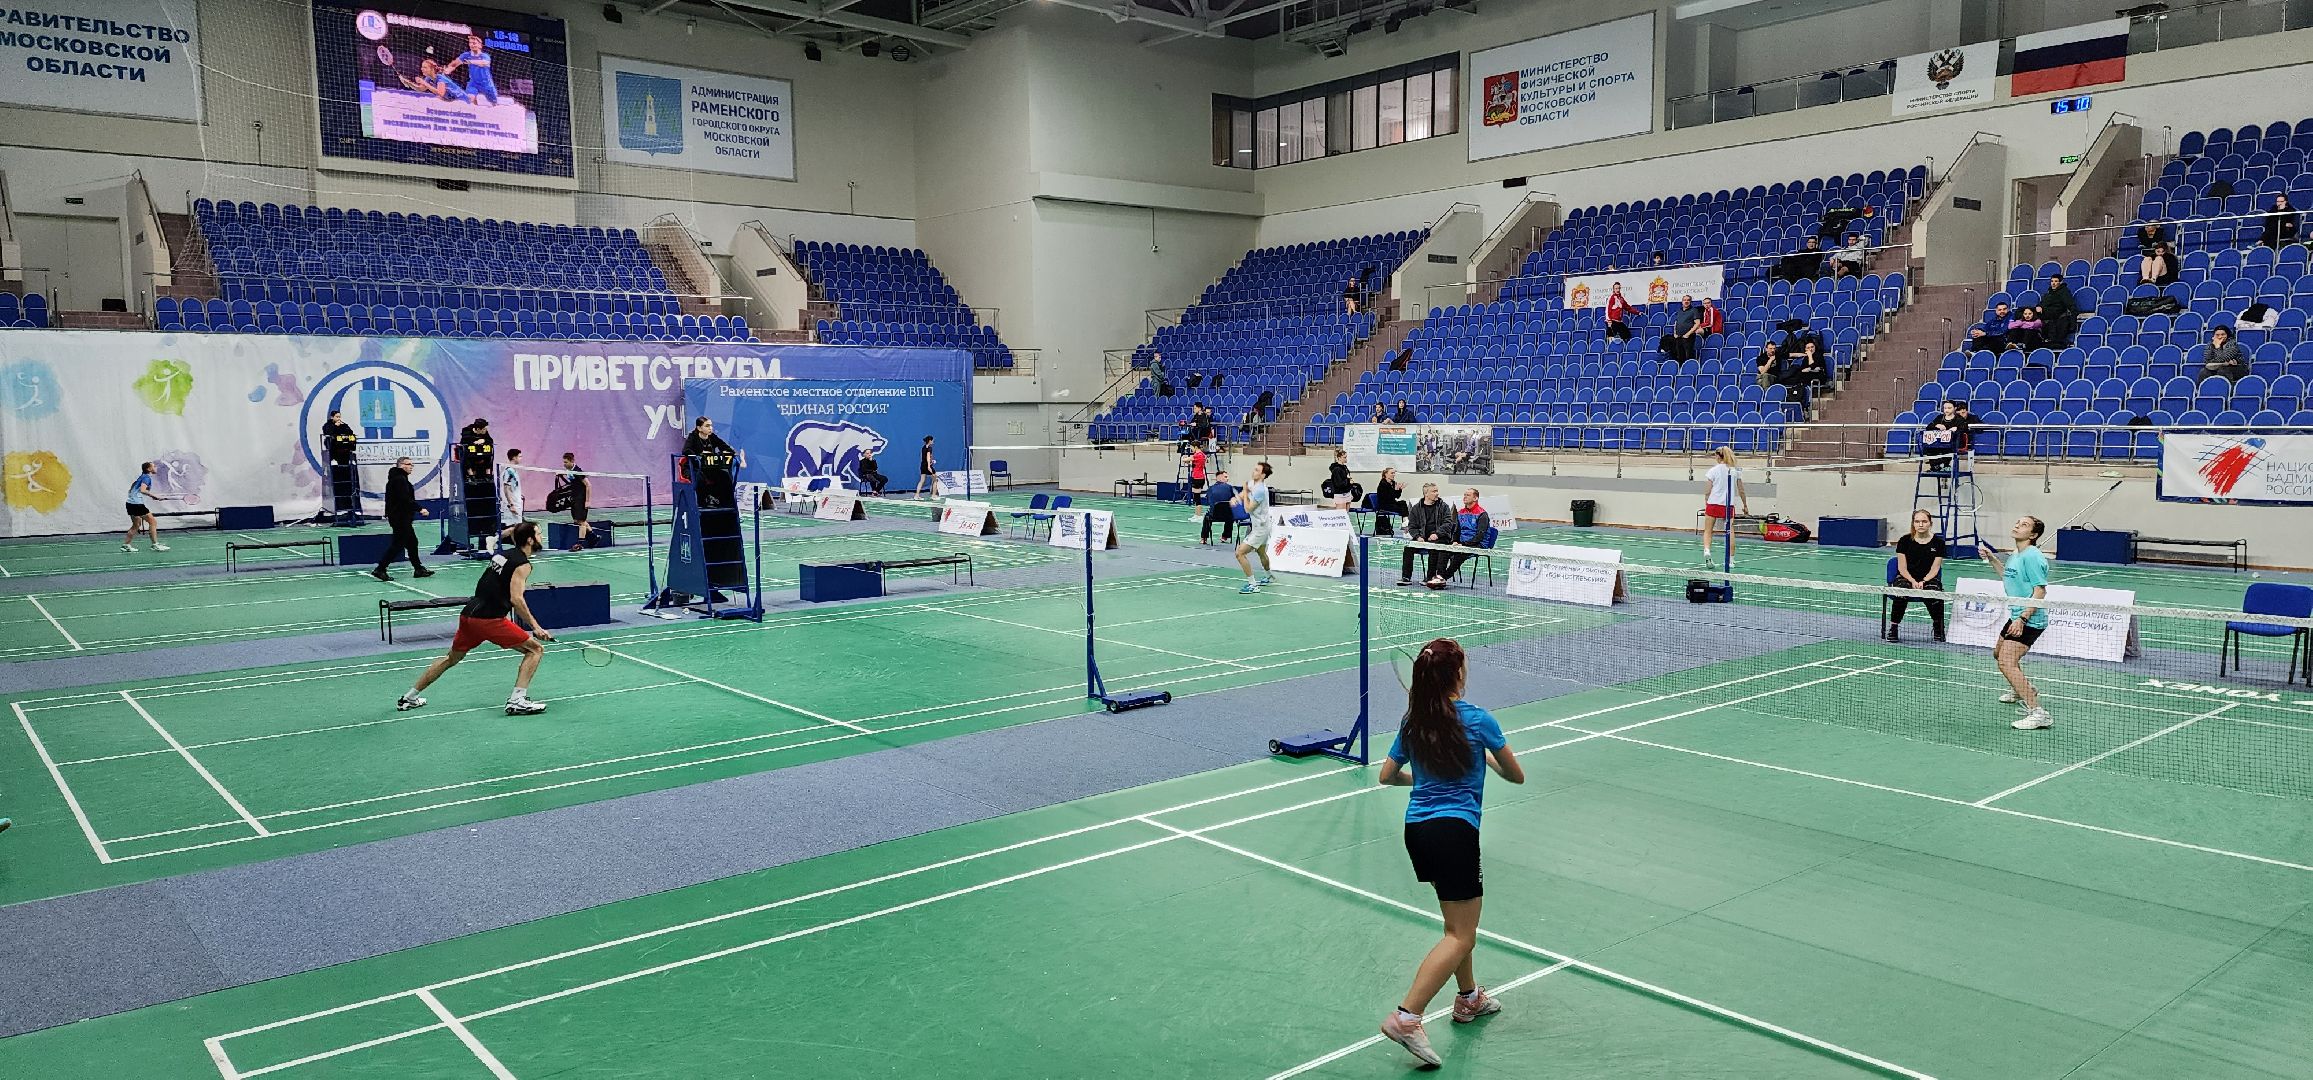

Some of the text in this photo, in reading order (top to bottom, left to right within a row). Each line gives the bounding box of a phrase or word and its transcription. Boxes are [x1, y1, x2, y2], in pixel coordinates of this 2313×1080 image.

[0, 31, 171, 63] МОСКОВСКОЙ
[26, 56, 146, 82] ОБЛАСТИ
[1520, 52, 1609, 79] МИНИСТЕРСТВО
[1520, 66, 1596, 90] ФИЗИЧЕСКОЙ
[691, 85, 779, 106] АДМИНИСТРАЦИЯ
[1520, 72, 1635, 103] КУЛЬТУРЫ И СПОРТА
[691, 100, 780, 122] РАМЕНСКОГО
[1520, 91, 1596, 114] МОСКОВСКОЙ
[2056, 97, 2089, 113] 15 10
[1519, 109, 1569, 126] ОБЛАСТИ
[692, 118, 780, 136] ГОРОДСКОГО ОКРУГА
[704, 131, 770, 147] МОСКОВСКОЙ
[715, 146, 760, 159] ОБЛАСТИ
[514, 353, 782, 391] ПРИВЕТСТВУЕМ
[720, 385, 934, 398] Раменское местное отделение ВПП
[643, 404, 684, 440] УЧ
[725, 455, 733, 465] 7
[2266, 461, 2313, 472] НАЦИО
[2265, 484, 2313, 496] РОССИ
[681, 511, 688, 529] 1
[1305, 555, 1338, 568] 25 ЛЕТ
[2048, 607, 2069, 617] НЫЙ
[2049, 619, 2113, 631] ОГЛЕБСКИЙ»
[2136, 678, 2281, 702] YONEX
